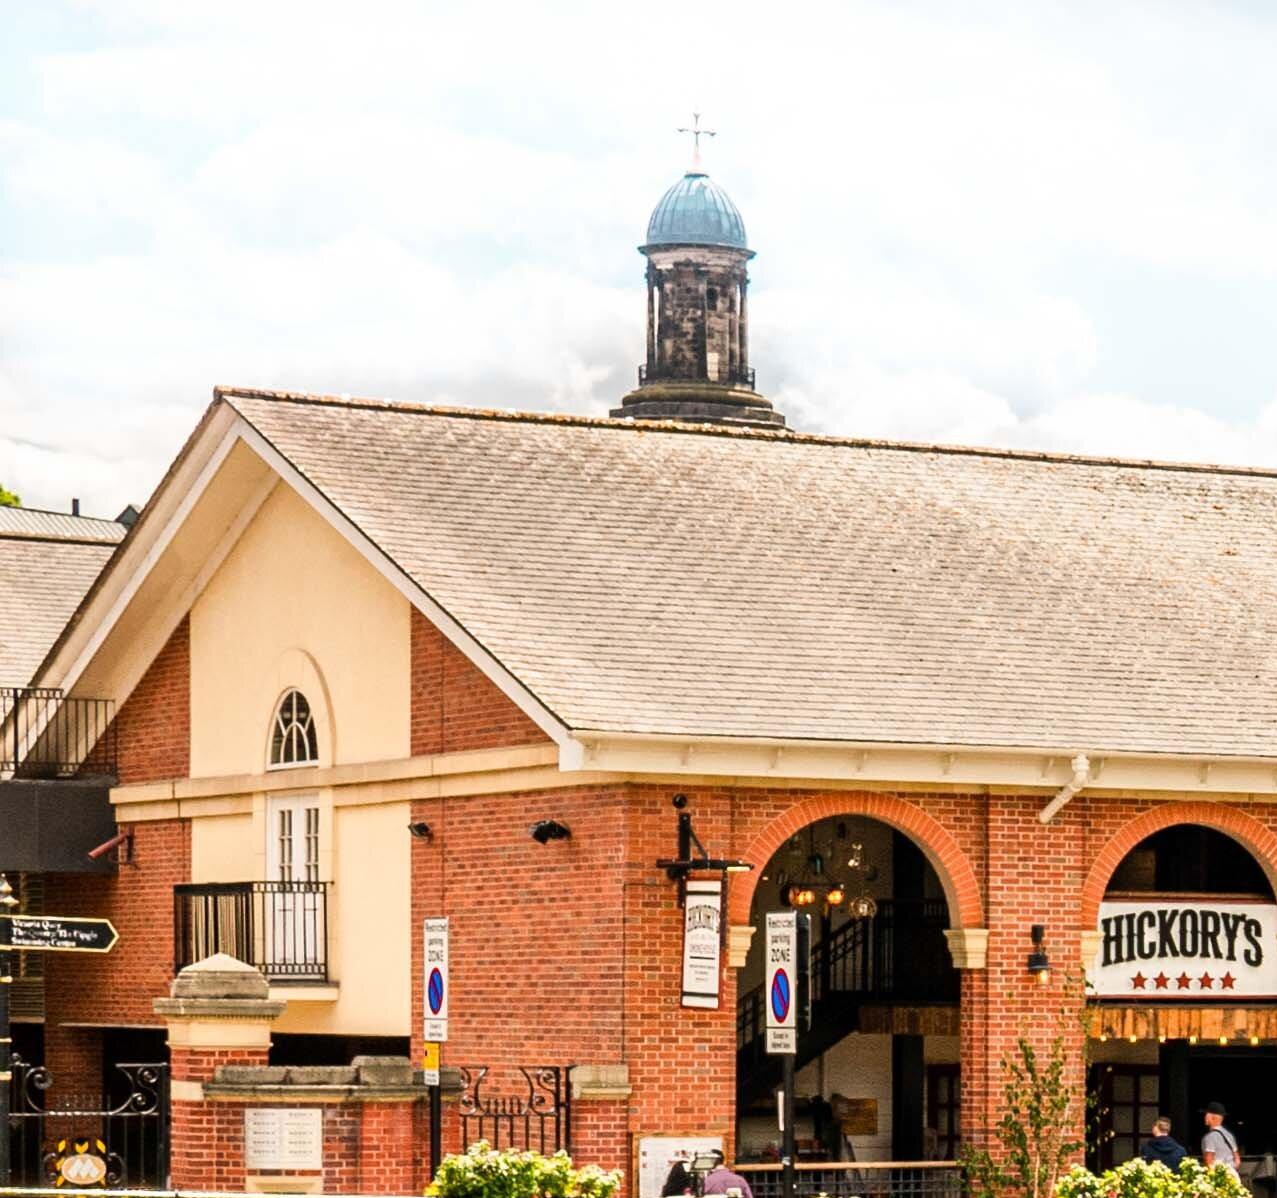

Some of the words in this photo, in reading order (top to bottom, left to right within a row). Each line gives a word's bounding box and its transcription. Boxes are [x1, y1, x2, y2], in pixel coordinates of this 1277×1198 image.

[1102, 909, 1263, 967] HICKORY'S
[428, 951, 443, 962] ZONE
[771, 948, 790, 962] ZONE
